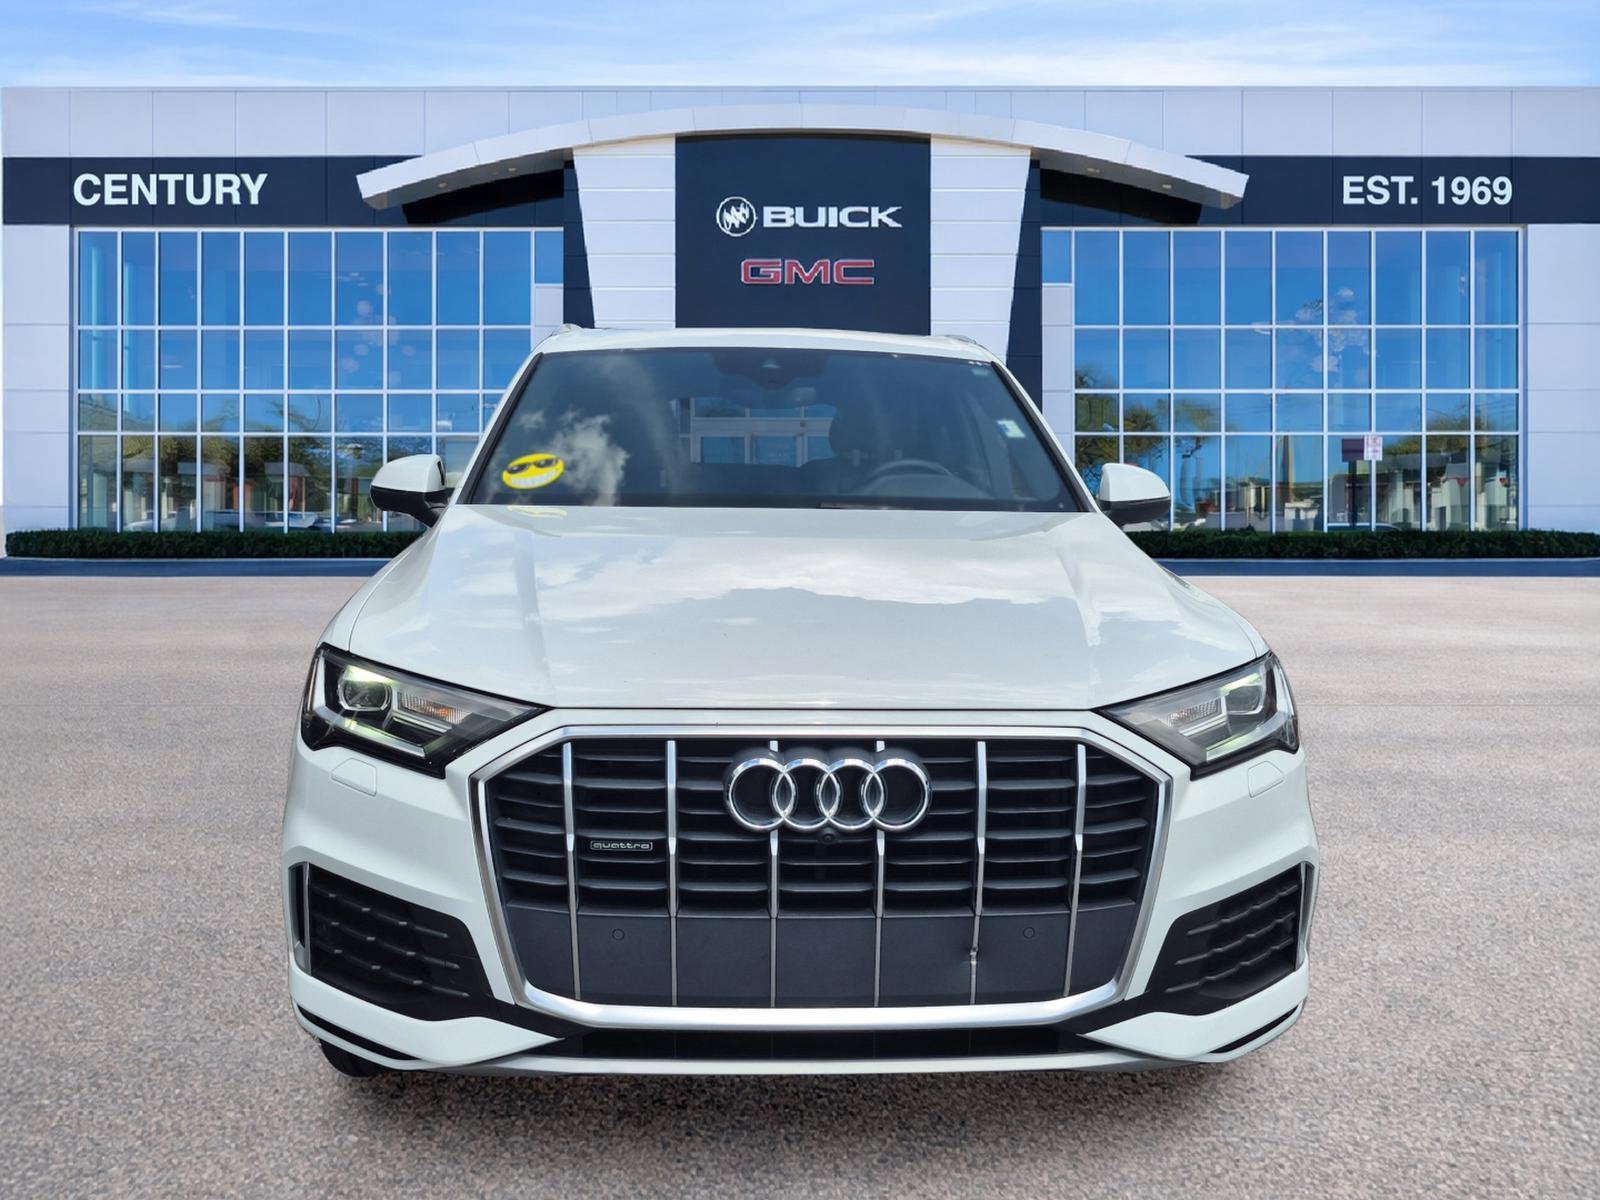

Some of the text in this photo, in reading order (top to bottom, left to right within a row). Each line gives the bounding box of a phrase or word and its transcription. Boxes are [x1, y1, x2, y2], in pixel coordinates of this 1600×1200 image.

[73, 173, 268, 206] CENTURY
[1342, 175, 1513, 205] EST. 1969
[763, 206, 902, 227] BUICK
[741, 259, 874, 284] GMC
[592, 841, 651, 850] quattro
